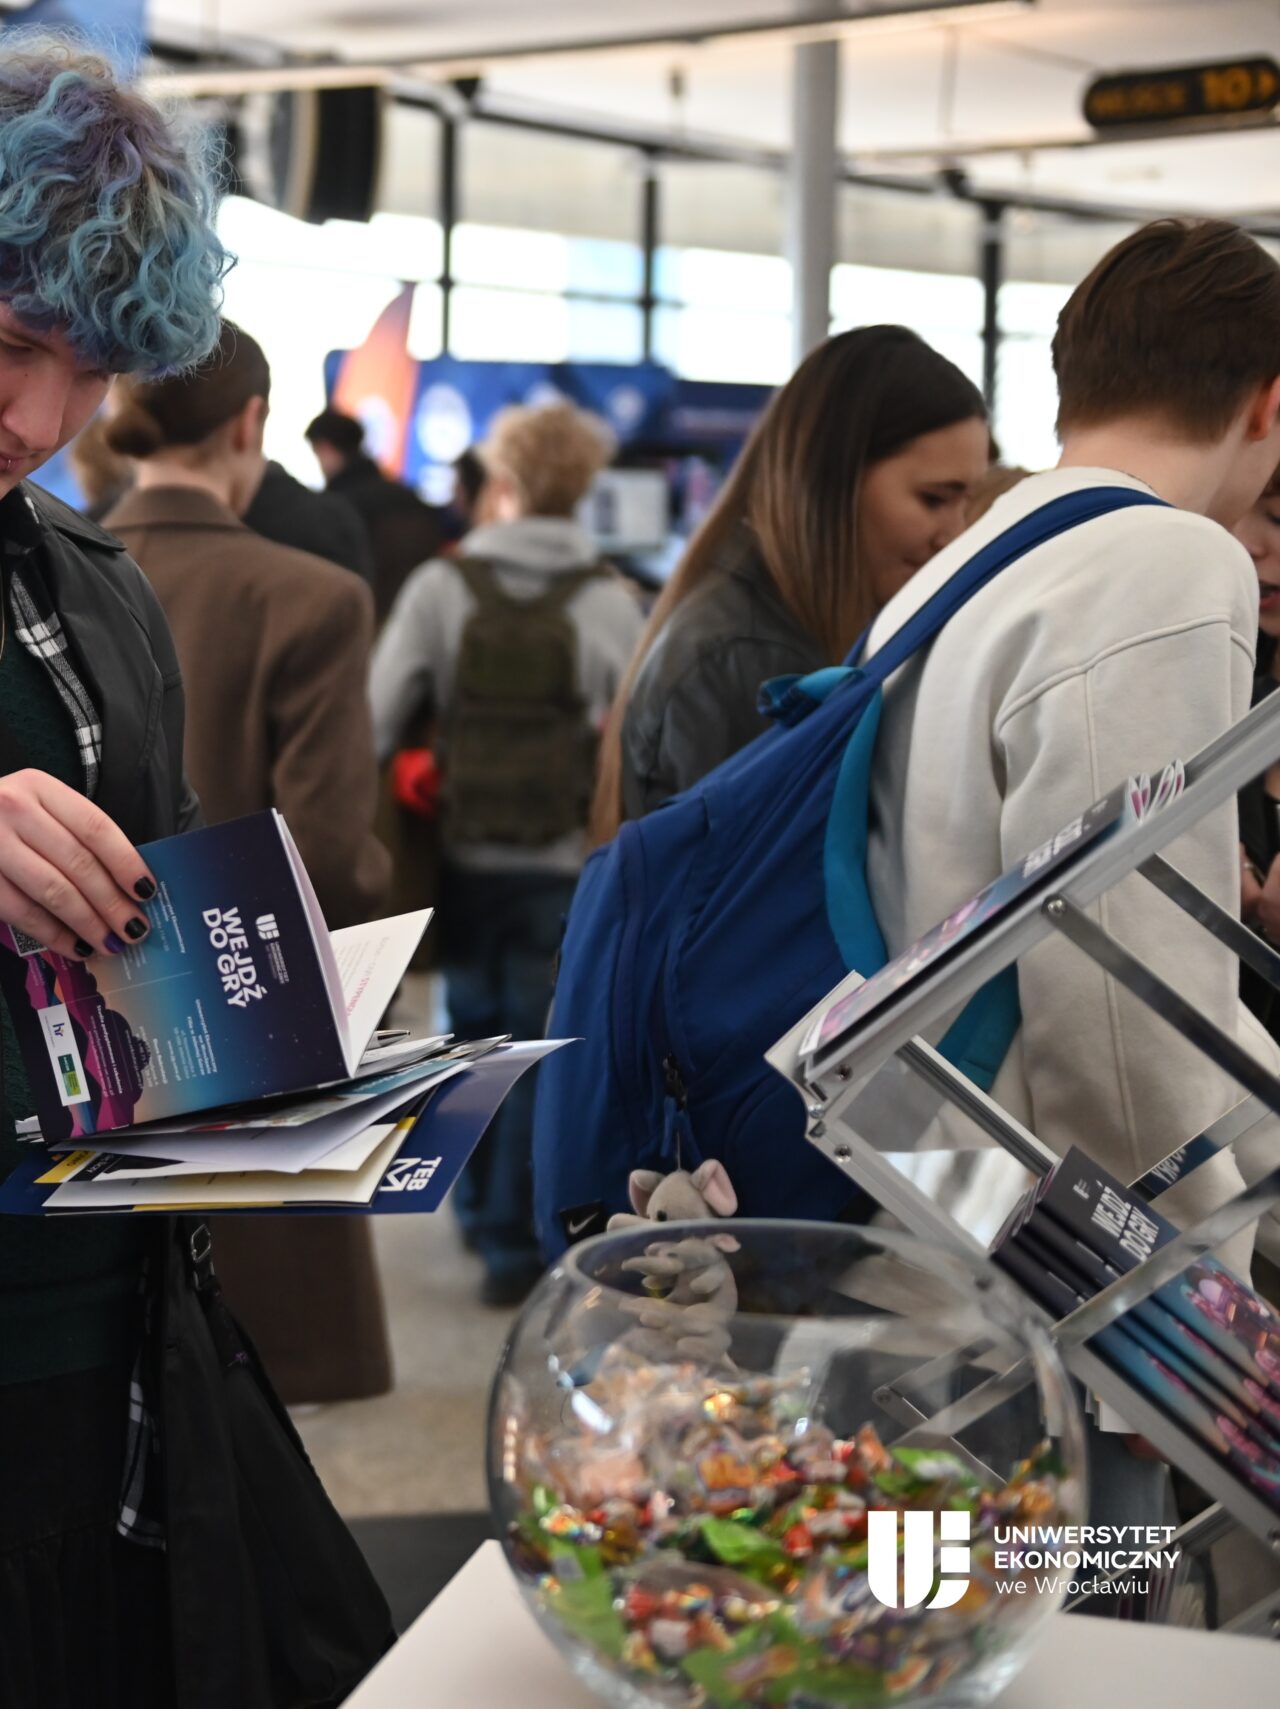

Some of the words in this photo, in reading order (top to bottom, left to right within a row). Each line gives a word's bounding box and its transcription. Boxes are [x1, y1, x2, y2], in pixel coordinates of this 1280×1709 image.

[202, 908, 228, 949] DO
[217, 953, 247, 1007] GRY
[222, 907, 268, 1002] WEJDŹ
[406, 1156, 442, 1191] TEB
[1090, 1179, 1132, 1239] WEJDŹ
[1127, 1206, 1160, 1244] GRY
[1119, 1229, 1152, 1262] DO
